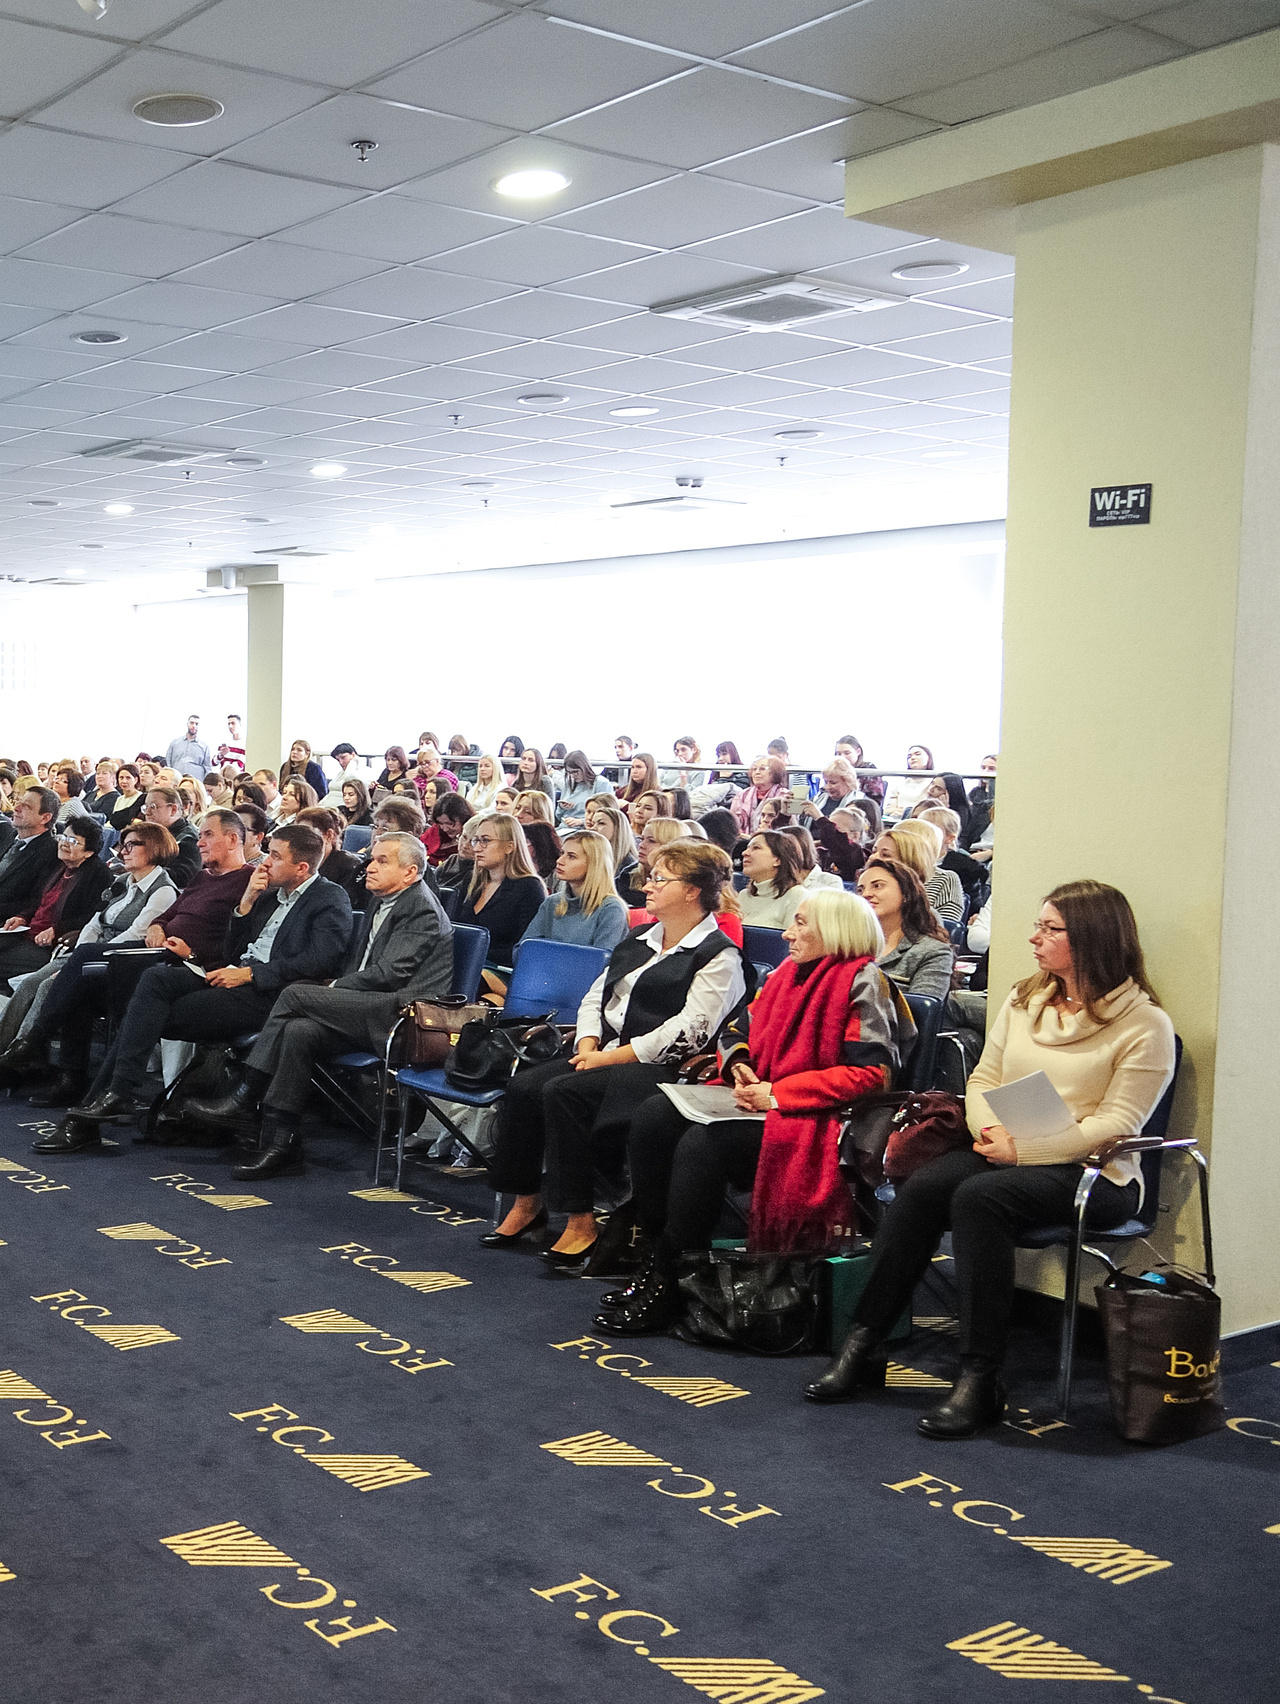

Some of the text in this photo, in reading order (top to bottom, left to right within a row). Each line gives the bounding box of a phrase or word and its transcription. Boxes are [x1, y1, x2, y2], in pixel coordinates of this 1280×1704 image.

[1094, 489, 1145, 510] Wi-Fi
[7, 1171, 71, 1193] F.C.
[149, 1173, 215, 1196] F.C.
[154, 1239, 233, 1270] F.C.
[320, 1241, 401, 1273] F.C.
[31, 1289, 112, 1325] F.C.
[356, 1332, 455, 1375] F.C.
[548, 1335, 652, 1377] F.C.
[13, 1399, 111, 1450] F.C.
[229, 1402, 335, 1454] F.C.
[646, 1466, 782, 1528] F.C.
[882, 1471, 1025, 1535] F.C.
[259, 1567, 398, 1649] F.C.
[529, 1572, 680, 1656] F.C.
